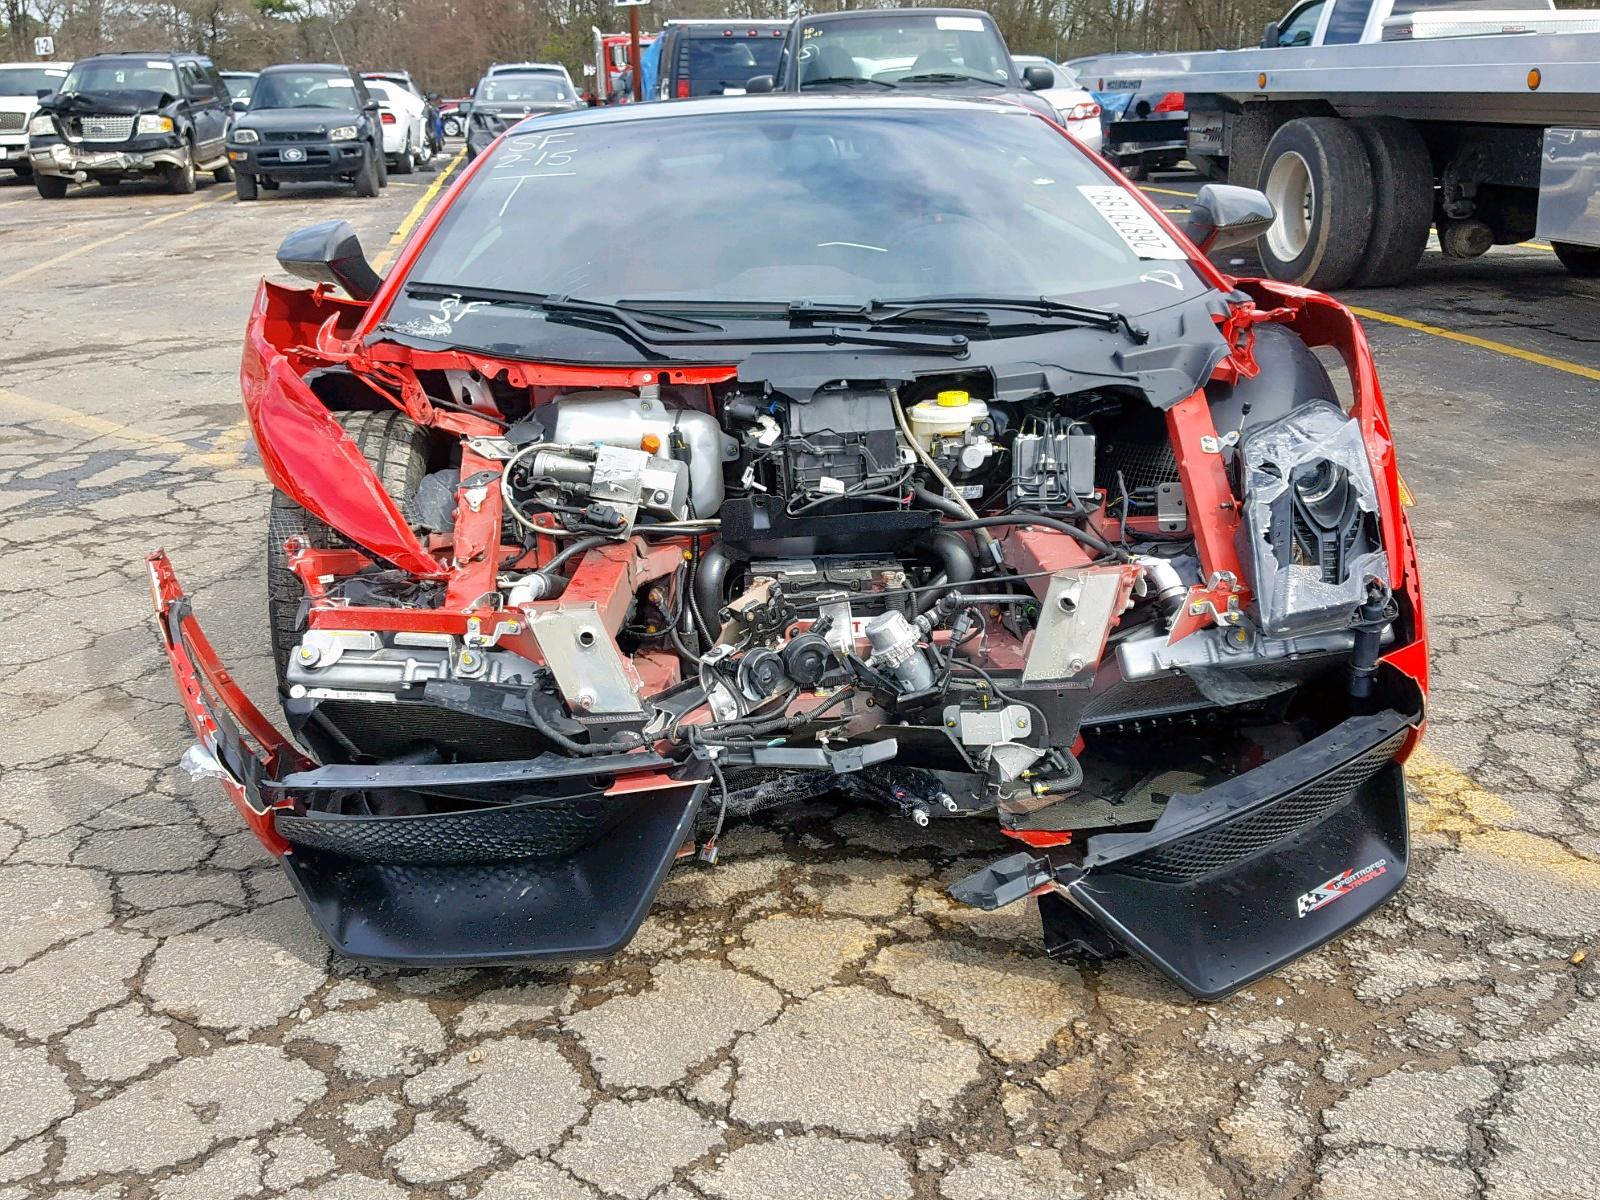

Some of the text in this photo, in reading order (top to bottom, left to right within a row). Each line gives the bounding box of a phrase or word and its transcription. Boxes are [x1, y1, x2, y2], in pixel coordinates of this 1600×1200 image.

[508, 132, 575, 152] SF
[493, 149, 579, 169] 2-15
[429, 294, 492, 324] SF
